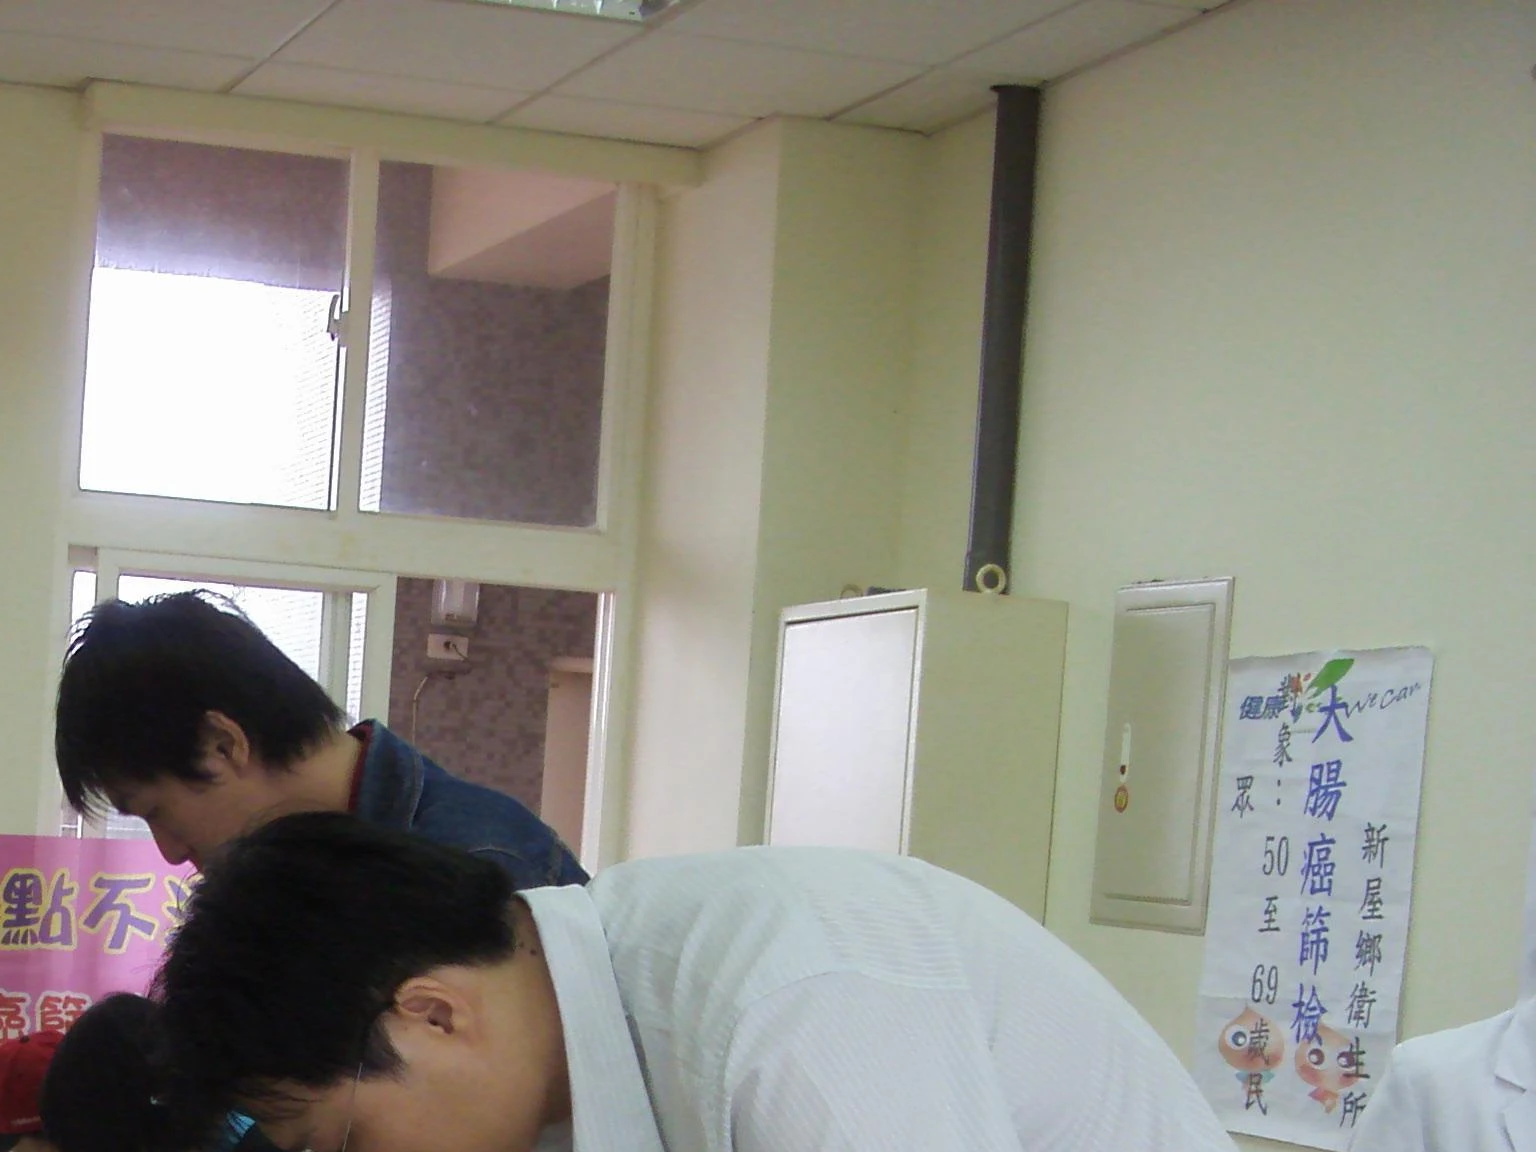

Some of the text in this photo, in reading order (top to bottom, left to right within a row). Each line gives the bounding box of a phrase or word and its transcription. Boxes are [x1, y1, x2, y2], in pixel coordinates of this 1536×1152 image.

[1290, 684, 1354, 1046] 大腸癌篩檢
[1340, 822, 1389, 1128] 新屋鄉衛生所
